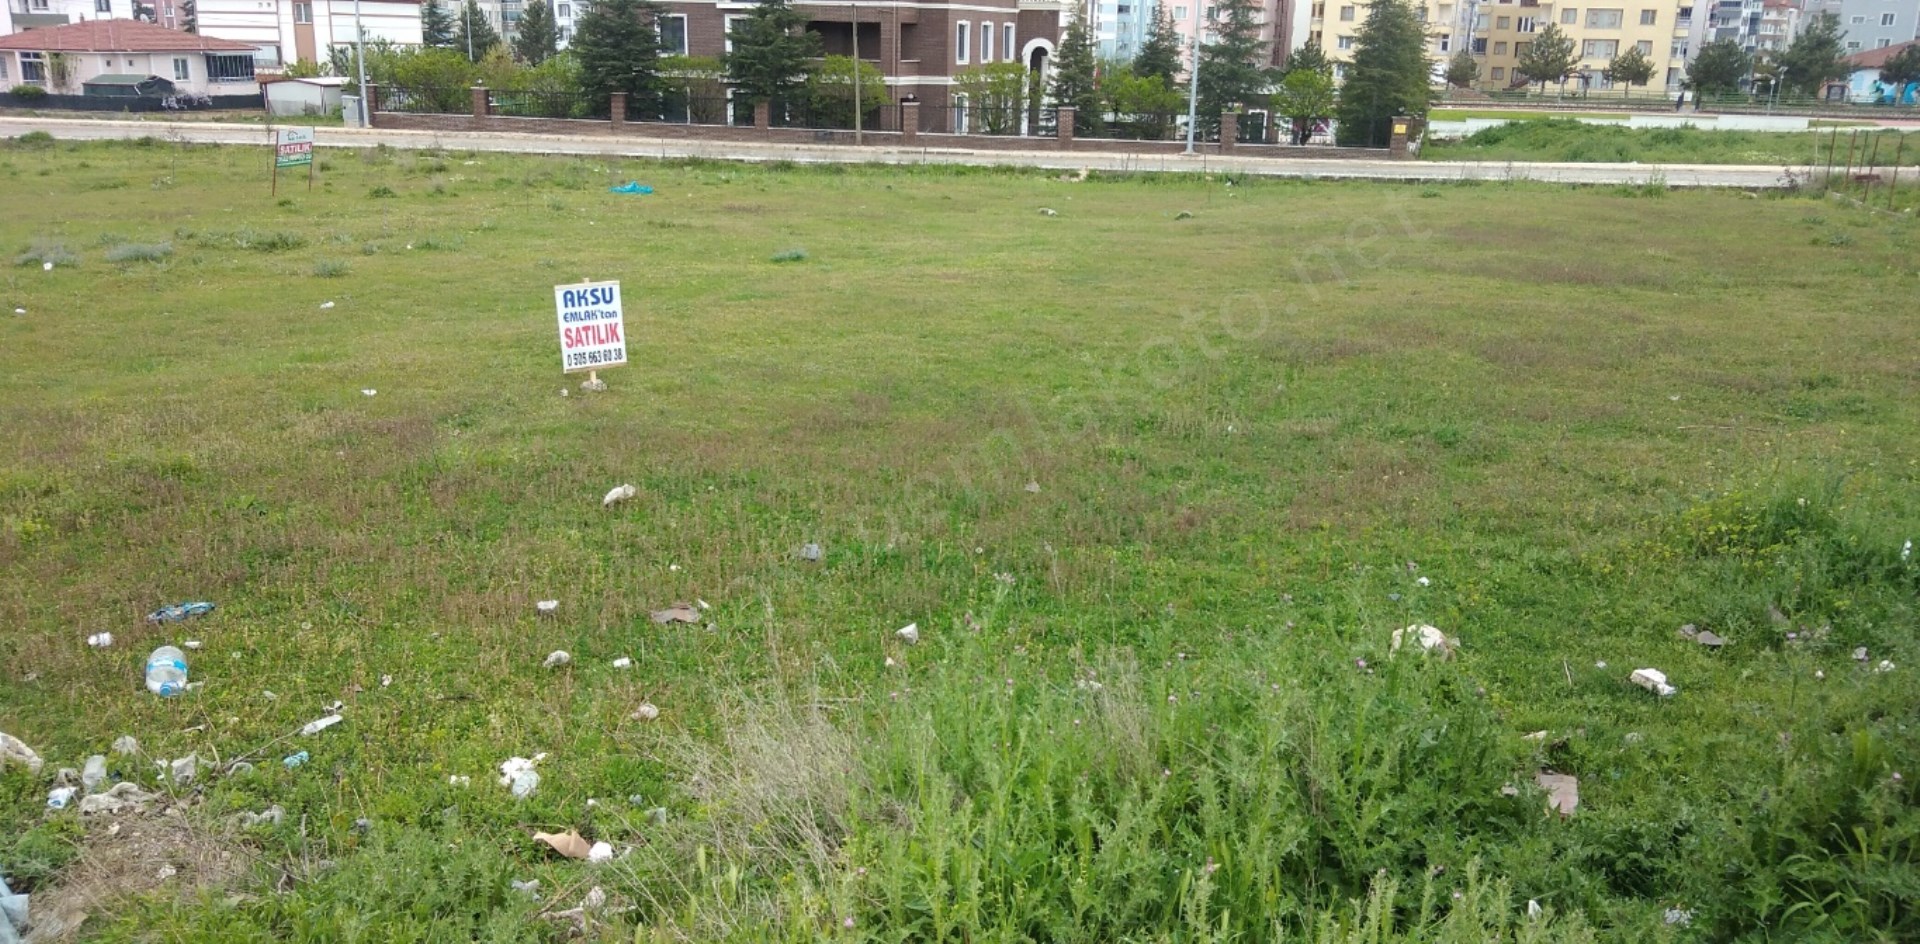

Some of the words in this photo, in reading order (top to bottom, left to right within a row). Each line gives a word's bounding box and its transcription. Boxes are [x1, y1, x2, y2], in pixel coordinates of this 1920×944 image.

[280, 143, 312, 156] SATILIK
[563, 286, 614, 308] AKSU
[564, 322, 621, 349] SATILIK
[567, 354, 572, 367] 0
